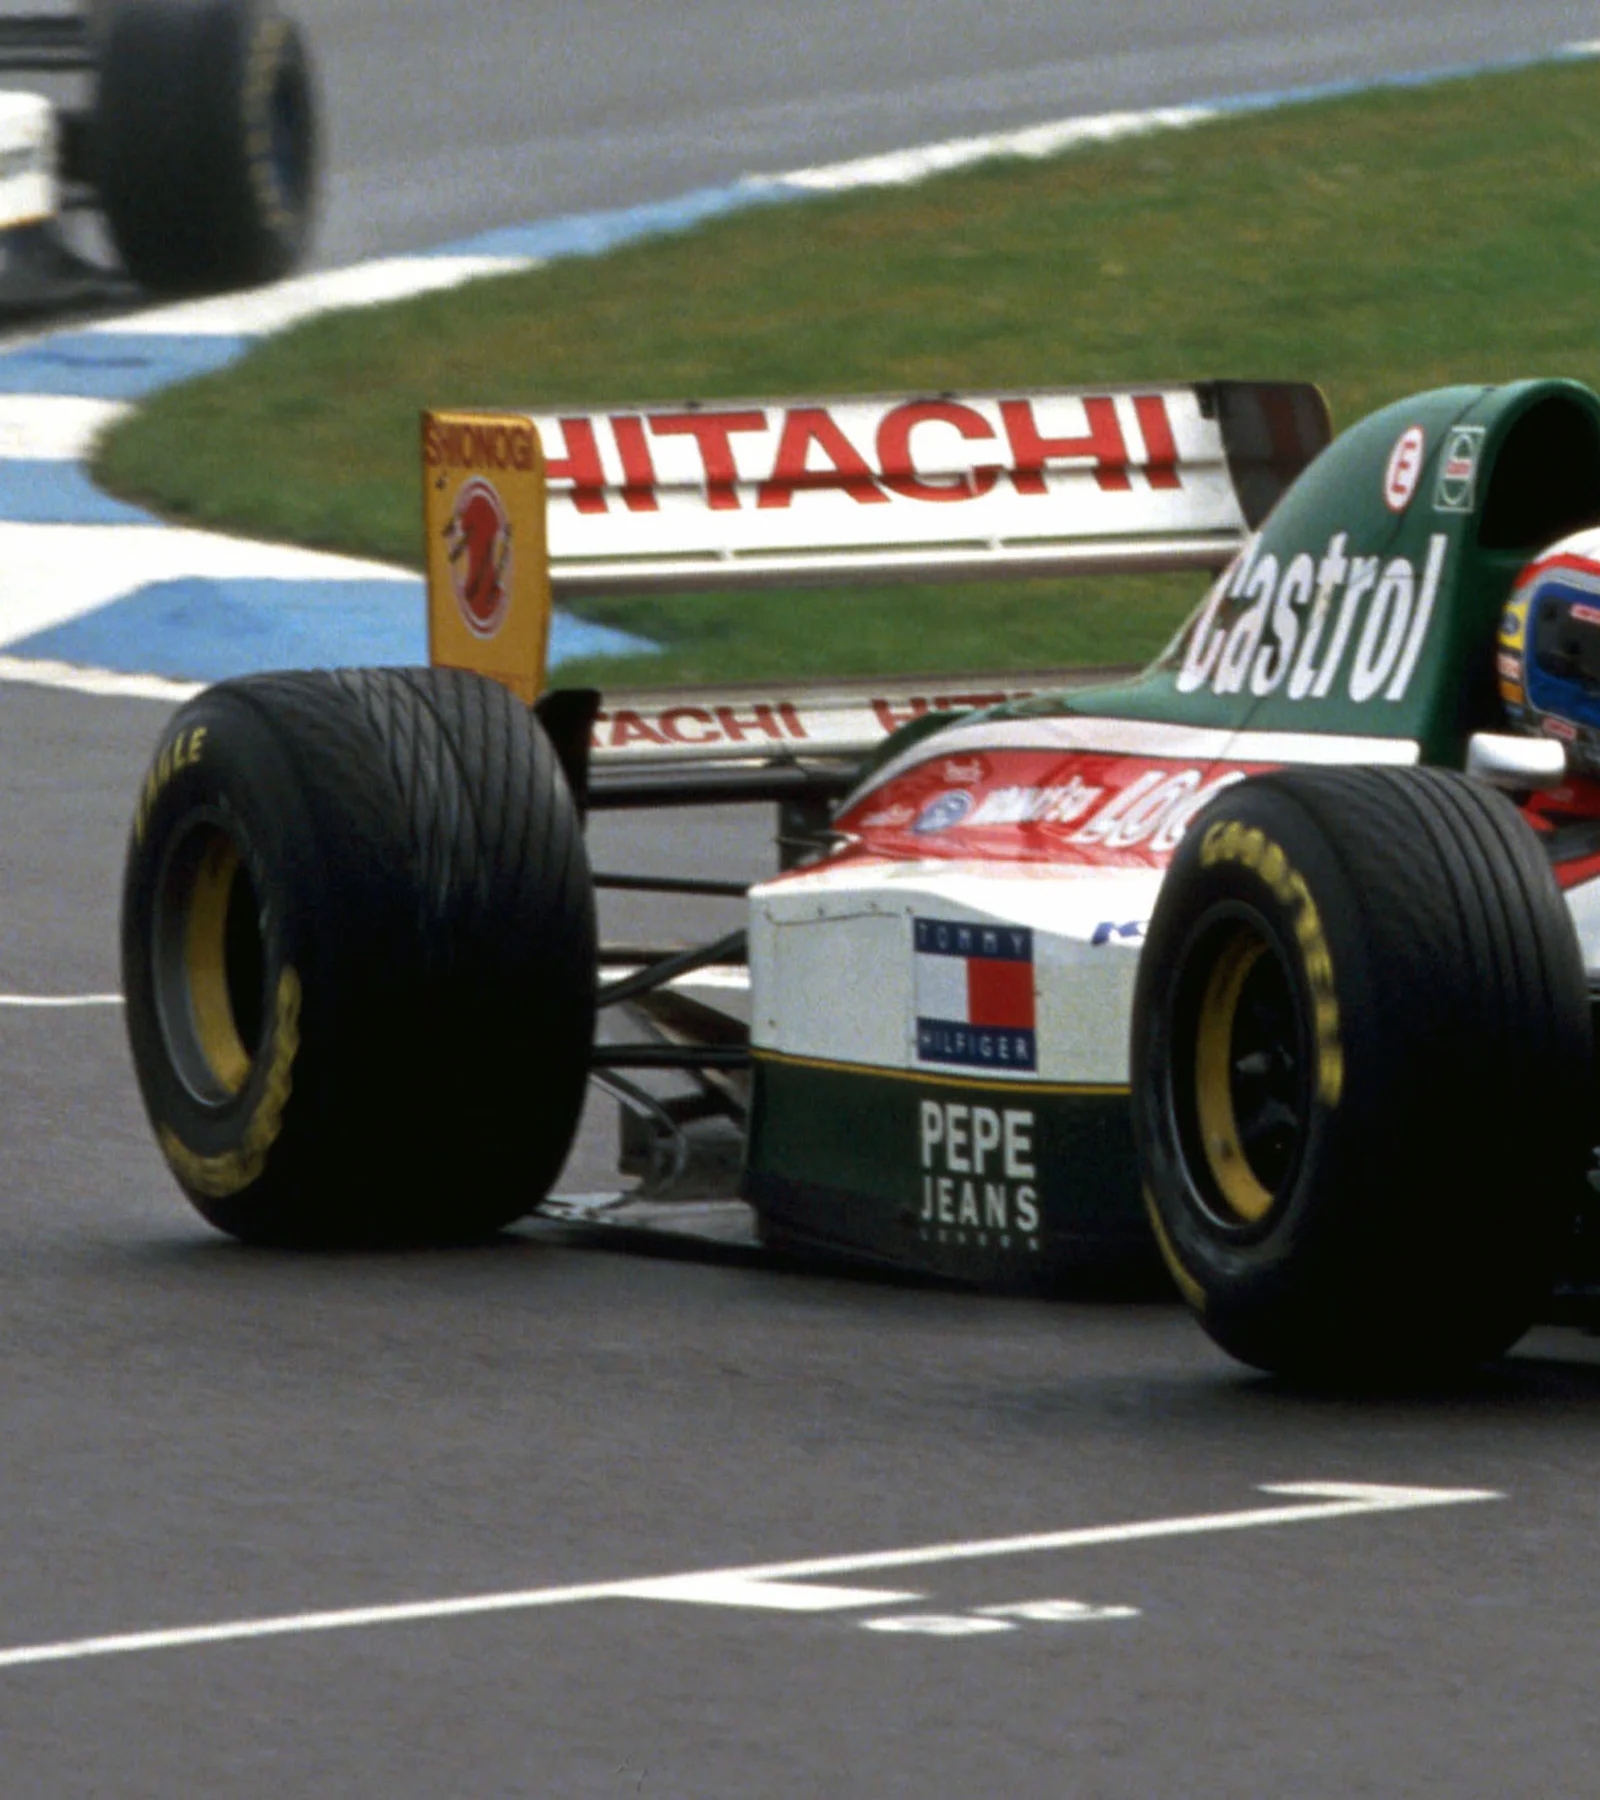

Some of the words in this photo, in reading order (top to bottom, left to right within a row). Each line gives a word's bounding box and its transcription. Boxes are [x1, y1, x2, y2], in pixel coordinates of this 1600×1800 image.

[545, 394, 1182, 514] HITACHI
[1389, 440, 1418, 495] E
[1176, 531, 1447, 703] Castrol
[919, 922, 1026, 954] TOMMY
[921, 1029, 1029, 1060] HILFIGER
[919, 1099, 1036, 1180] PEPE
[920, 1175, 1039, 1232] JEANS
